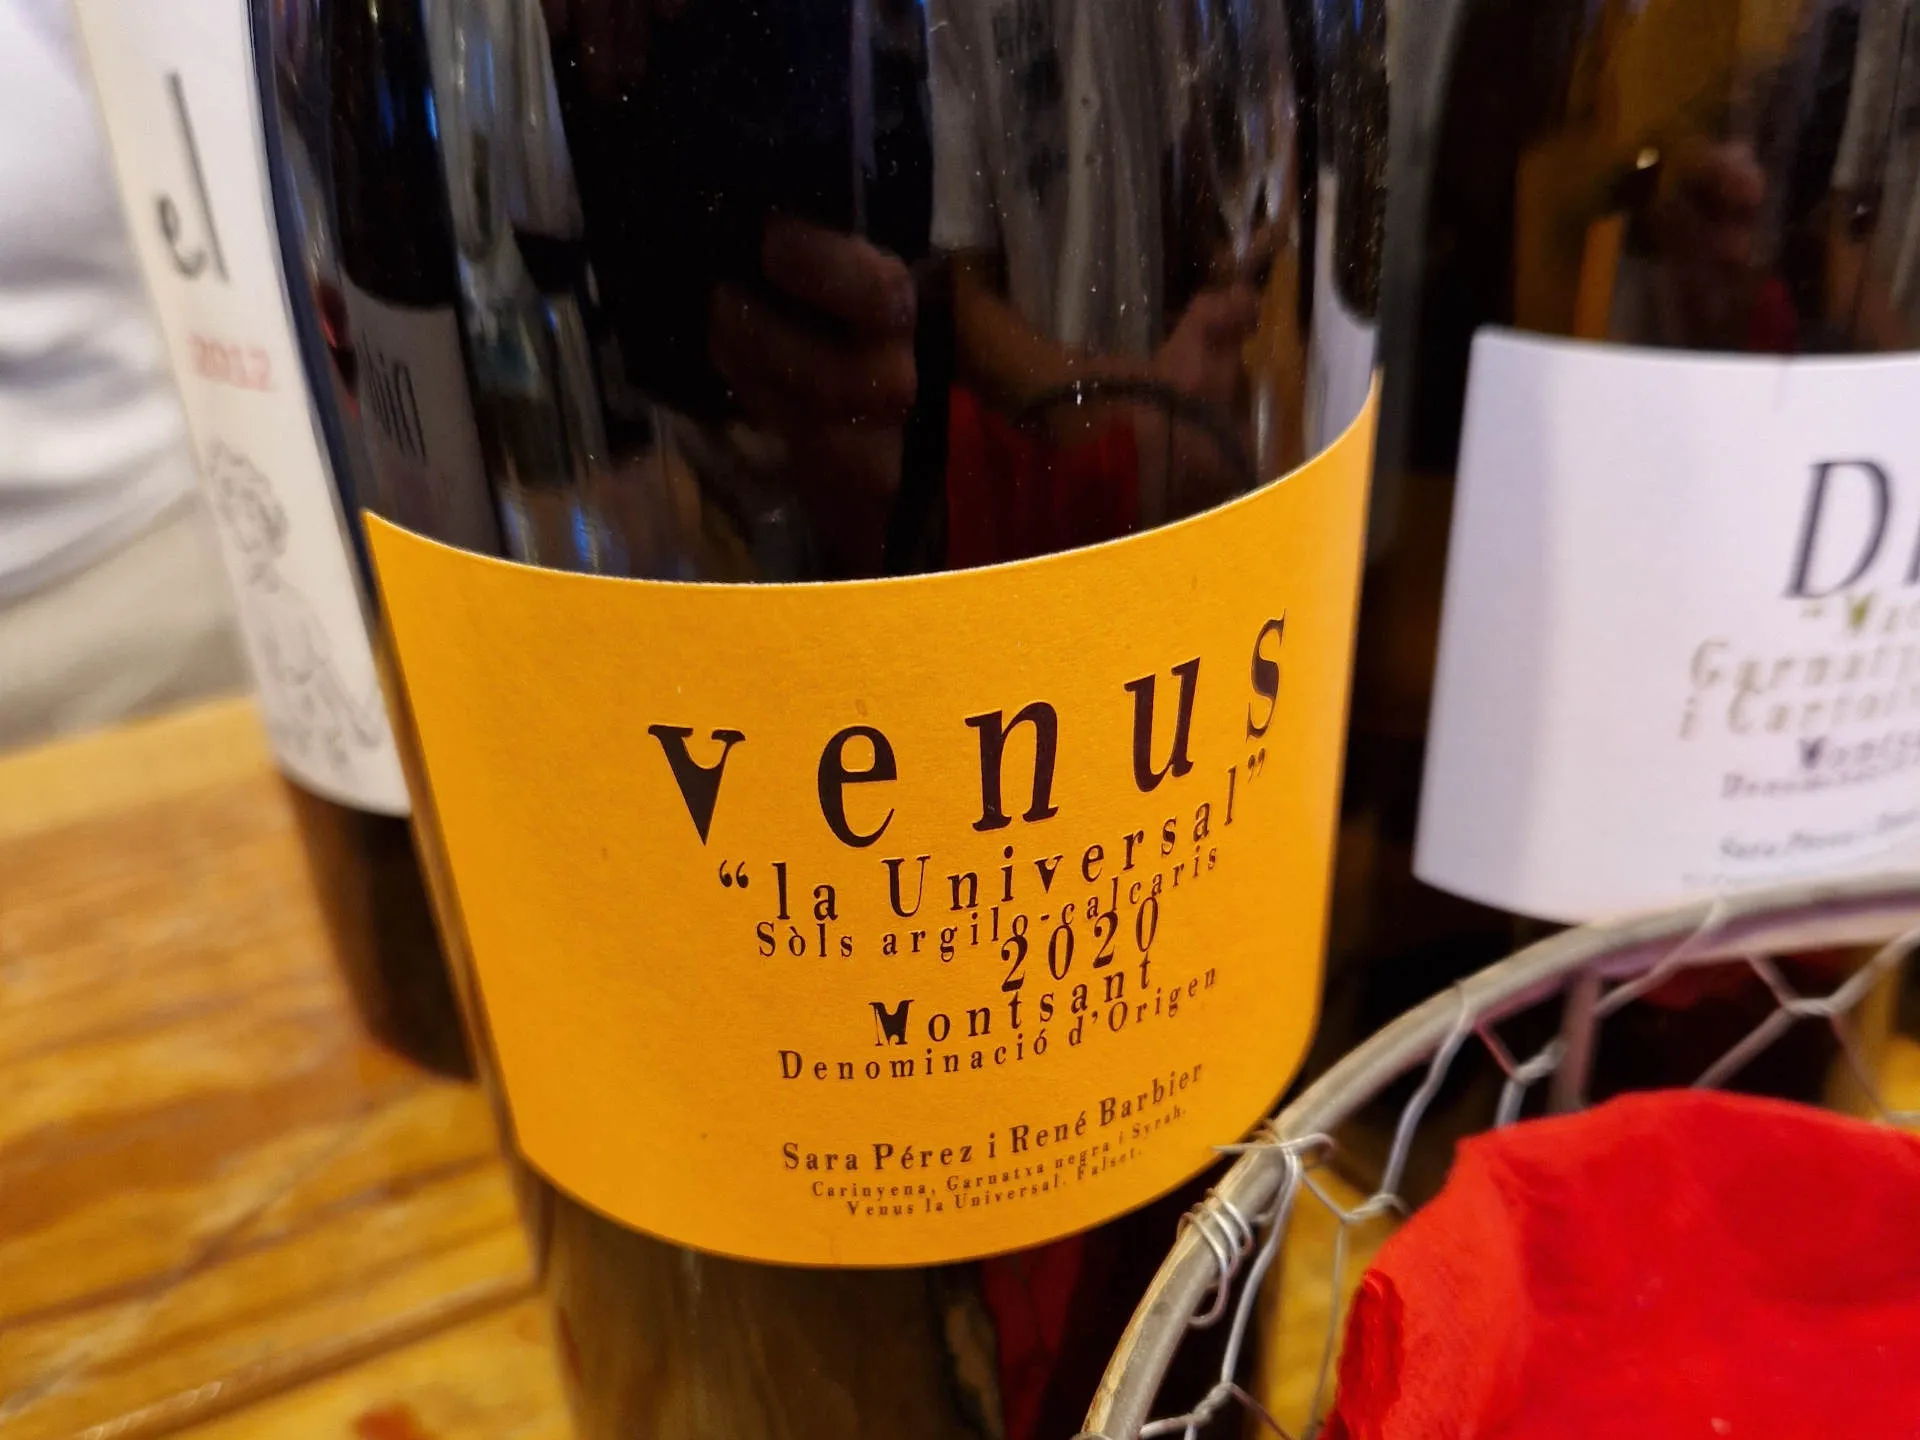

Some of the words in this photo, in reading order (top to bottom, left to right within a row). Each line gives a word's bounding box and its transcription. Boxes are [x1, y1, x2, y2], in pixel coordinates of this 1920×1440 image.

[647, 607, 1287, 849] venus
[756, 921, 853, 957] Sòls
[882, 846, 1218, 963] argilo-calcaris
[1001, 895, 1159, 993] 2020
[869, 951, 1151, 1047] Montsant
[778, 1027, 1048, 1080] Denominació
[782, 1142, 859, 1170] Sara
[872, 1142, 973, 1171] Pérez
[988, 1132, 996, 1159] i
[1009, 1110, 1087, 1154] René
[1098, 1063, 1202, 1127] Barbier
[812, 1181, 936, 1201] Carinyena,
[946, 1162, 1044, 1192] Garnatxa
[1054, 1140, 1110, 1168] negra
[847, 1200, 914, 1216] Venus
[925, 1198, 944, 1213] la
[954, 1172, 1067, 1209] Universal.
